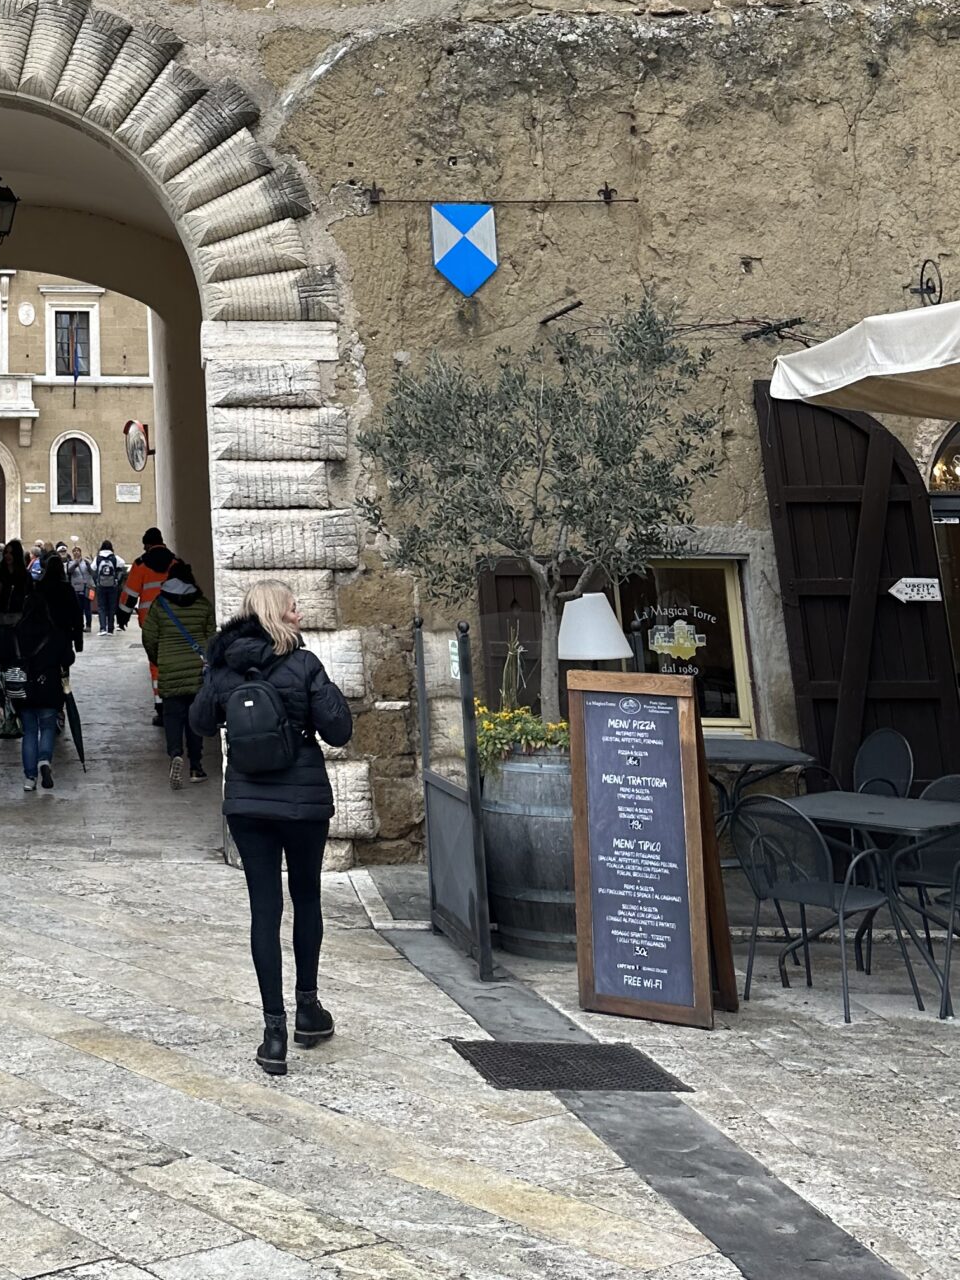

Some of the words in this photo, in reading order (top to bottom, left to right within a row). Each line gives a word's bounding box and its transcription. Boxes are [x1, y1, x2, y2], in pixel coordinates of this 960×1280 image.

[634, 609, 648, 621] La
[650, 604, 688, 618] Magica
[690, 605, 717, 624] Torre
[661, 663, 676, 673] dal
[679, 664, 699, 675] 1989
[633, 720, 656, 731] PIZZA
[626, 776, 668, 788] TRATTORIA
[638, 840, 661, 852] TIPICO
[623, 975, 641, 987] FREE
